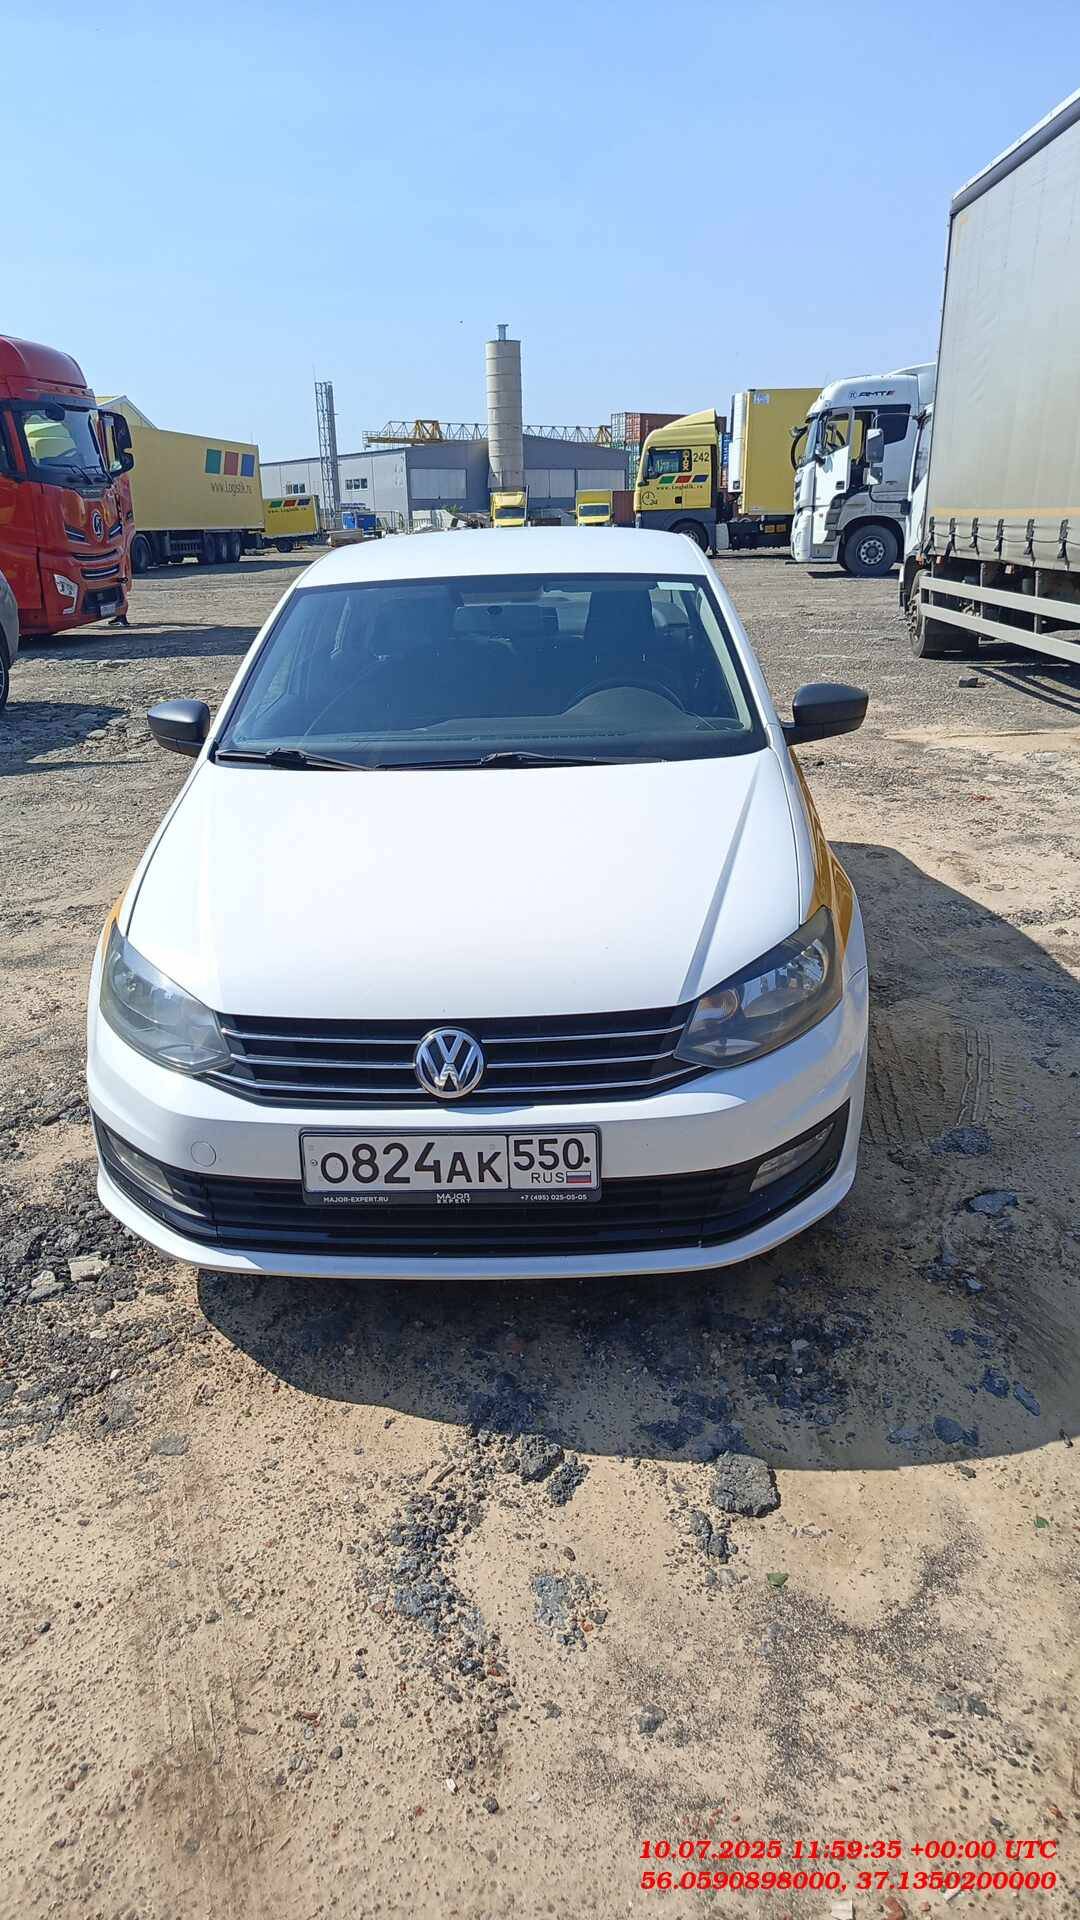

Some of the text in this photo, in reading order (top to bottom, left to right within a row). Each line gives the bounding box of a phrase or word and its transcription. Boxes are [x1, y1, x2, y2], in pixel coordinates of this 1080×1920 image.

[693, 453, 710, 462] 242
[513, 1138, 585, 1171] 550
[531, 1172, 565, 1184] RUS
